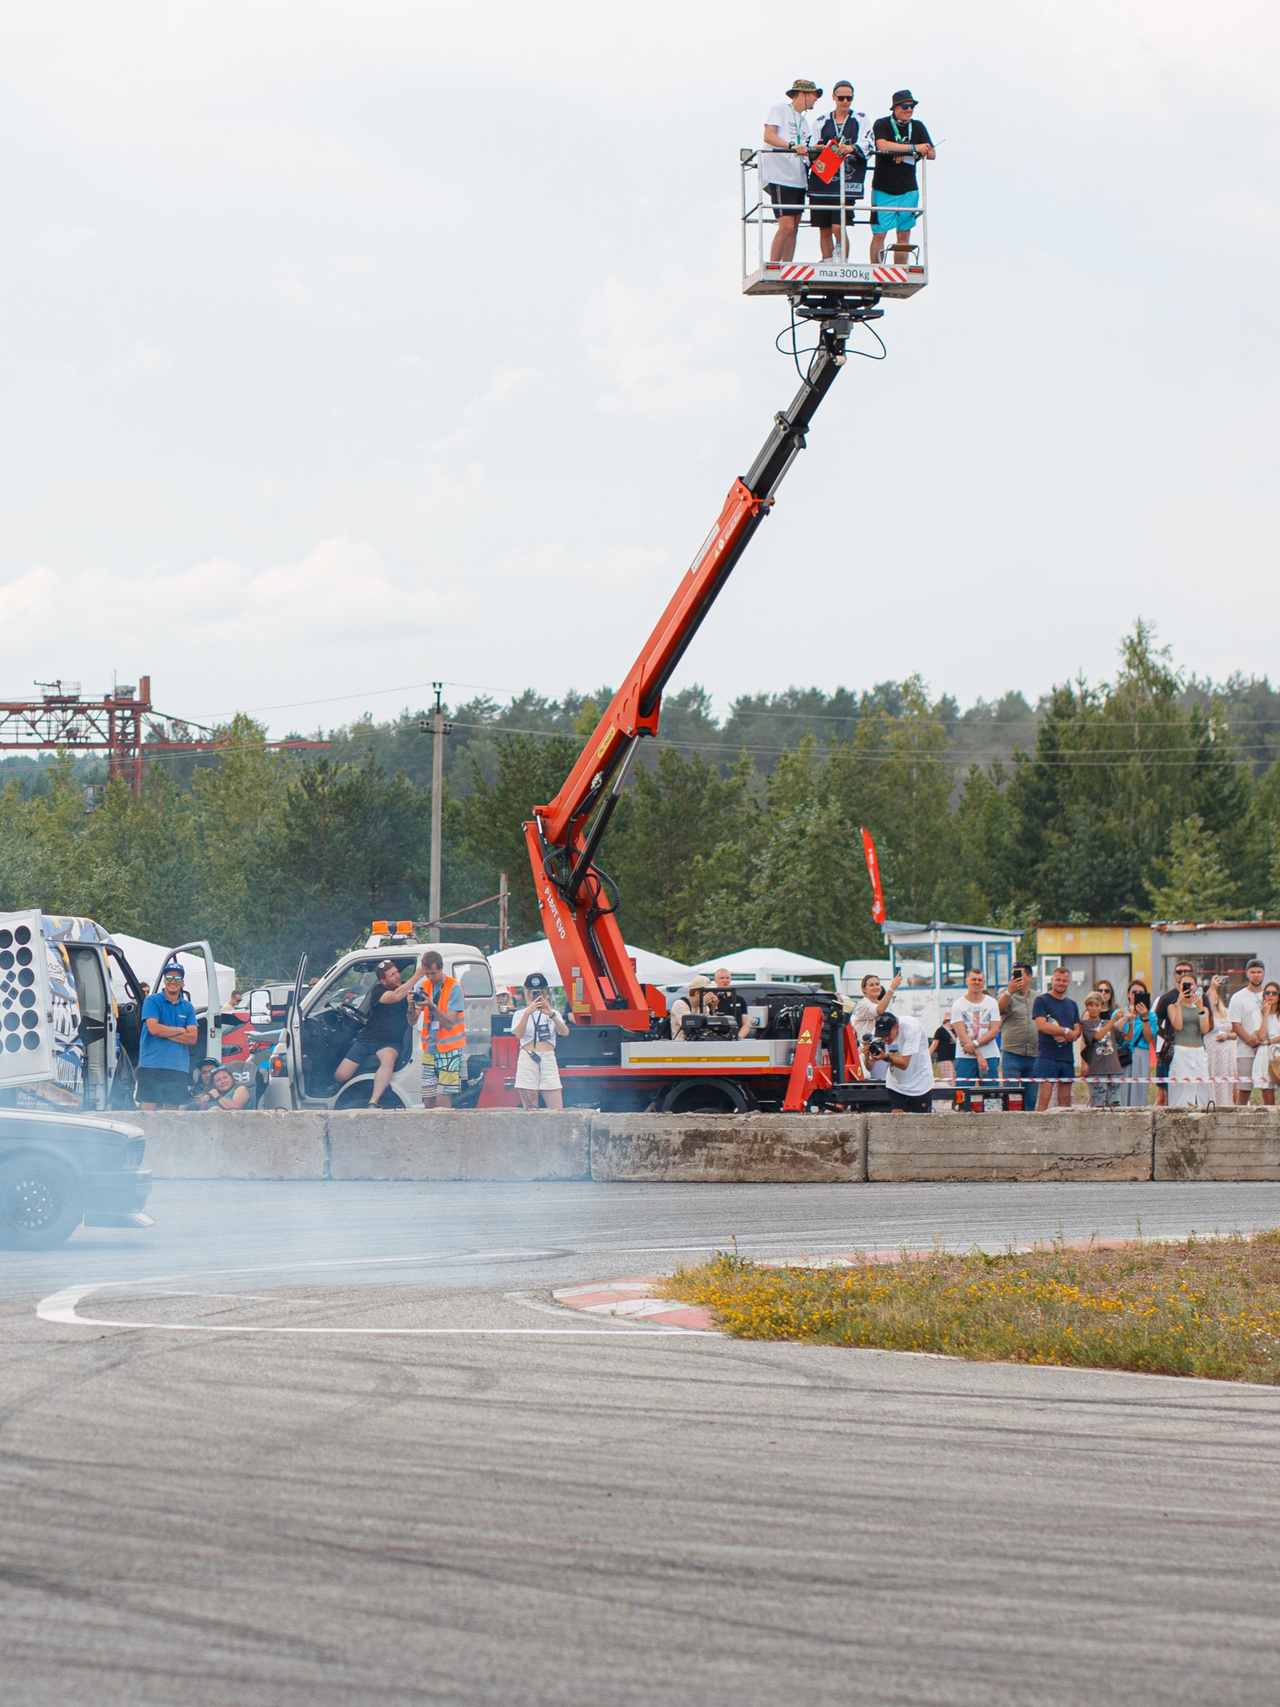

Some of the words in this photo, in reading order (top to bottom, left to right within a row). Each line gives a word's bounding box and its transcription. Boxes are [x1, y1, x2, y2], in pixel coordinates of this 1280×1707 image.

[819, 269, 838, 277] max
[839, 269, 858, 278] 300
[859, 270, 870, 281] kg
[555, 917, 566, 939] EVO
